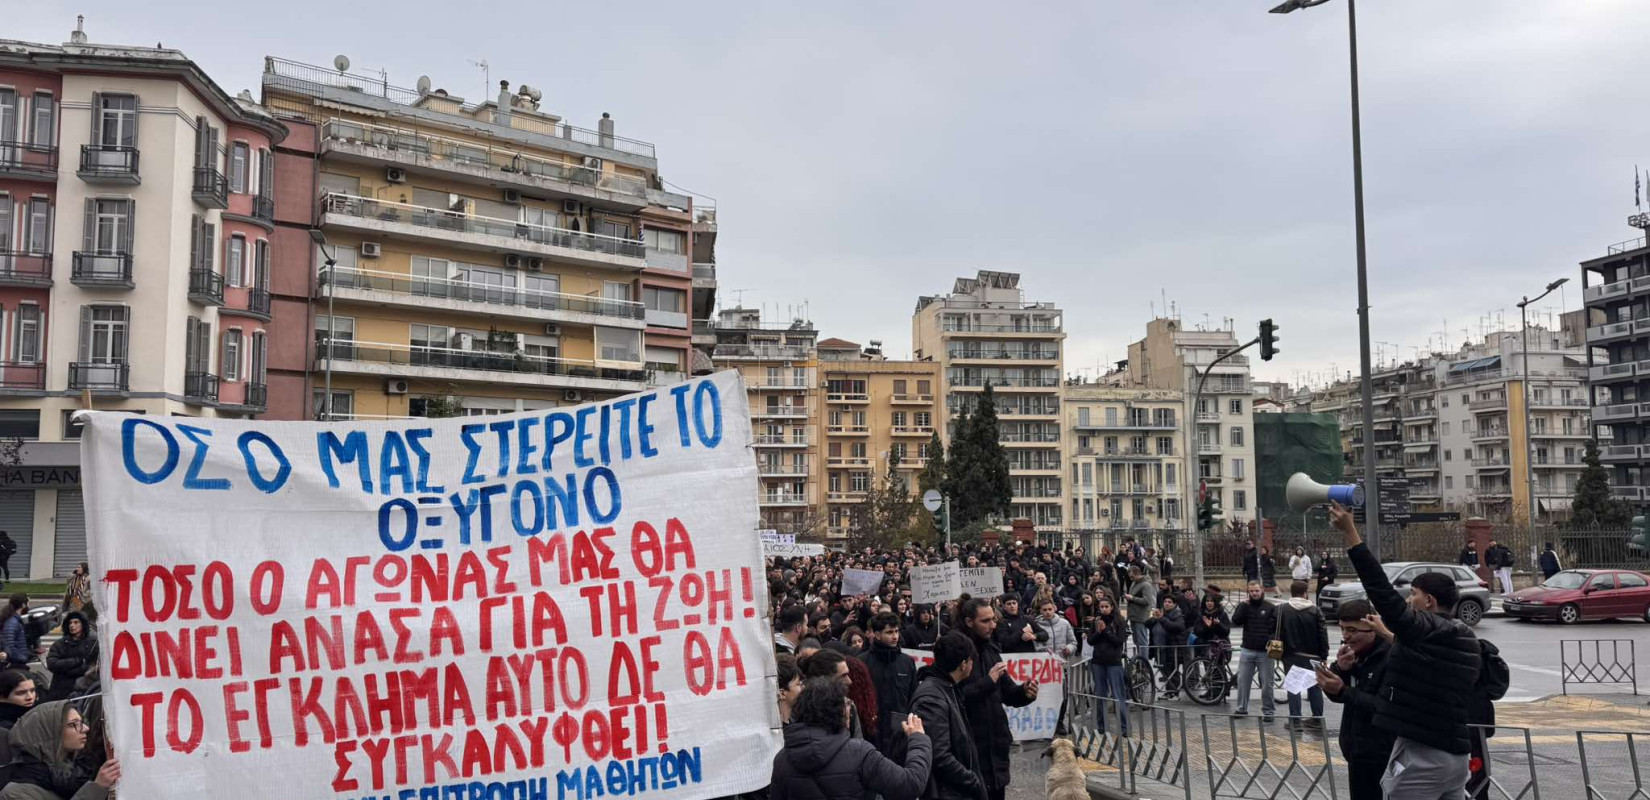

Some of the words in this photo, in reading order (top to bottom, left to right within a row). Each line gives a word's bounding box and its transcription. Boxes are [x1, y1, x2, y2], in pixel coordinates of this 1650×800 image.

[121, 418, 292, 493] ΟΣΟ
[317, 428, 445, 495] ΜΑΣ
[460, 393, 658, 485] ΣΤΕΡΕΙΤΕ
[671, 380, 722, 448] ΤΟ
[378, 465, 622, 551] ΟΞΥΓΟΝΟ
[103, 560, 234, 622] ΤΟΣΟ
[250, 560, 285, 616] Ο
[306, 545, 517, 609] ΑΓΩΝΑΣ
[528, 528, 620, 587] ΜΑΣ
[632, 518, 697, 578] ΘΑ
[111, 625, 242, 681] ΔΙΝΕΙ
[270, 606, 465, 675] ΑΝΑΣΑ
[479, 591, 568, 652] ΓΙΑ
[579, 580, 639, 638] ΤΗ
[130, 687, 204, 758] ΤΟ
[223, 661, 476, 753] ΕΓΚΛΗΜΑ
[486, 646, 590, 711] ΑΥΤΟ
[608, 635, 666, 706] ΔΕ
[683, 626, 748, 696] ΘΑ
[556, 746, 703, 800] ΜΑΘΗΤΩΝ
